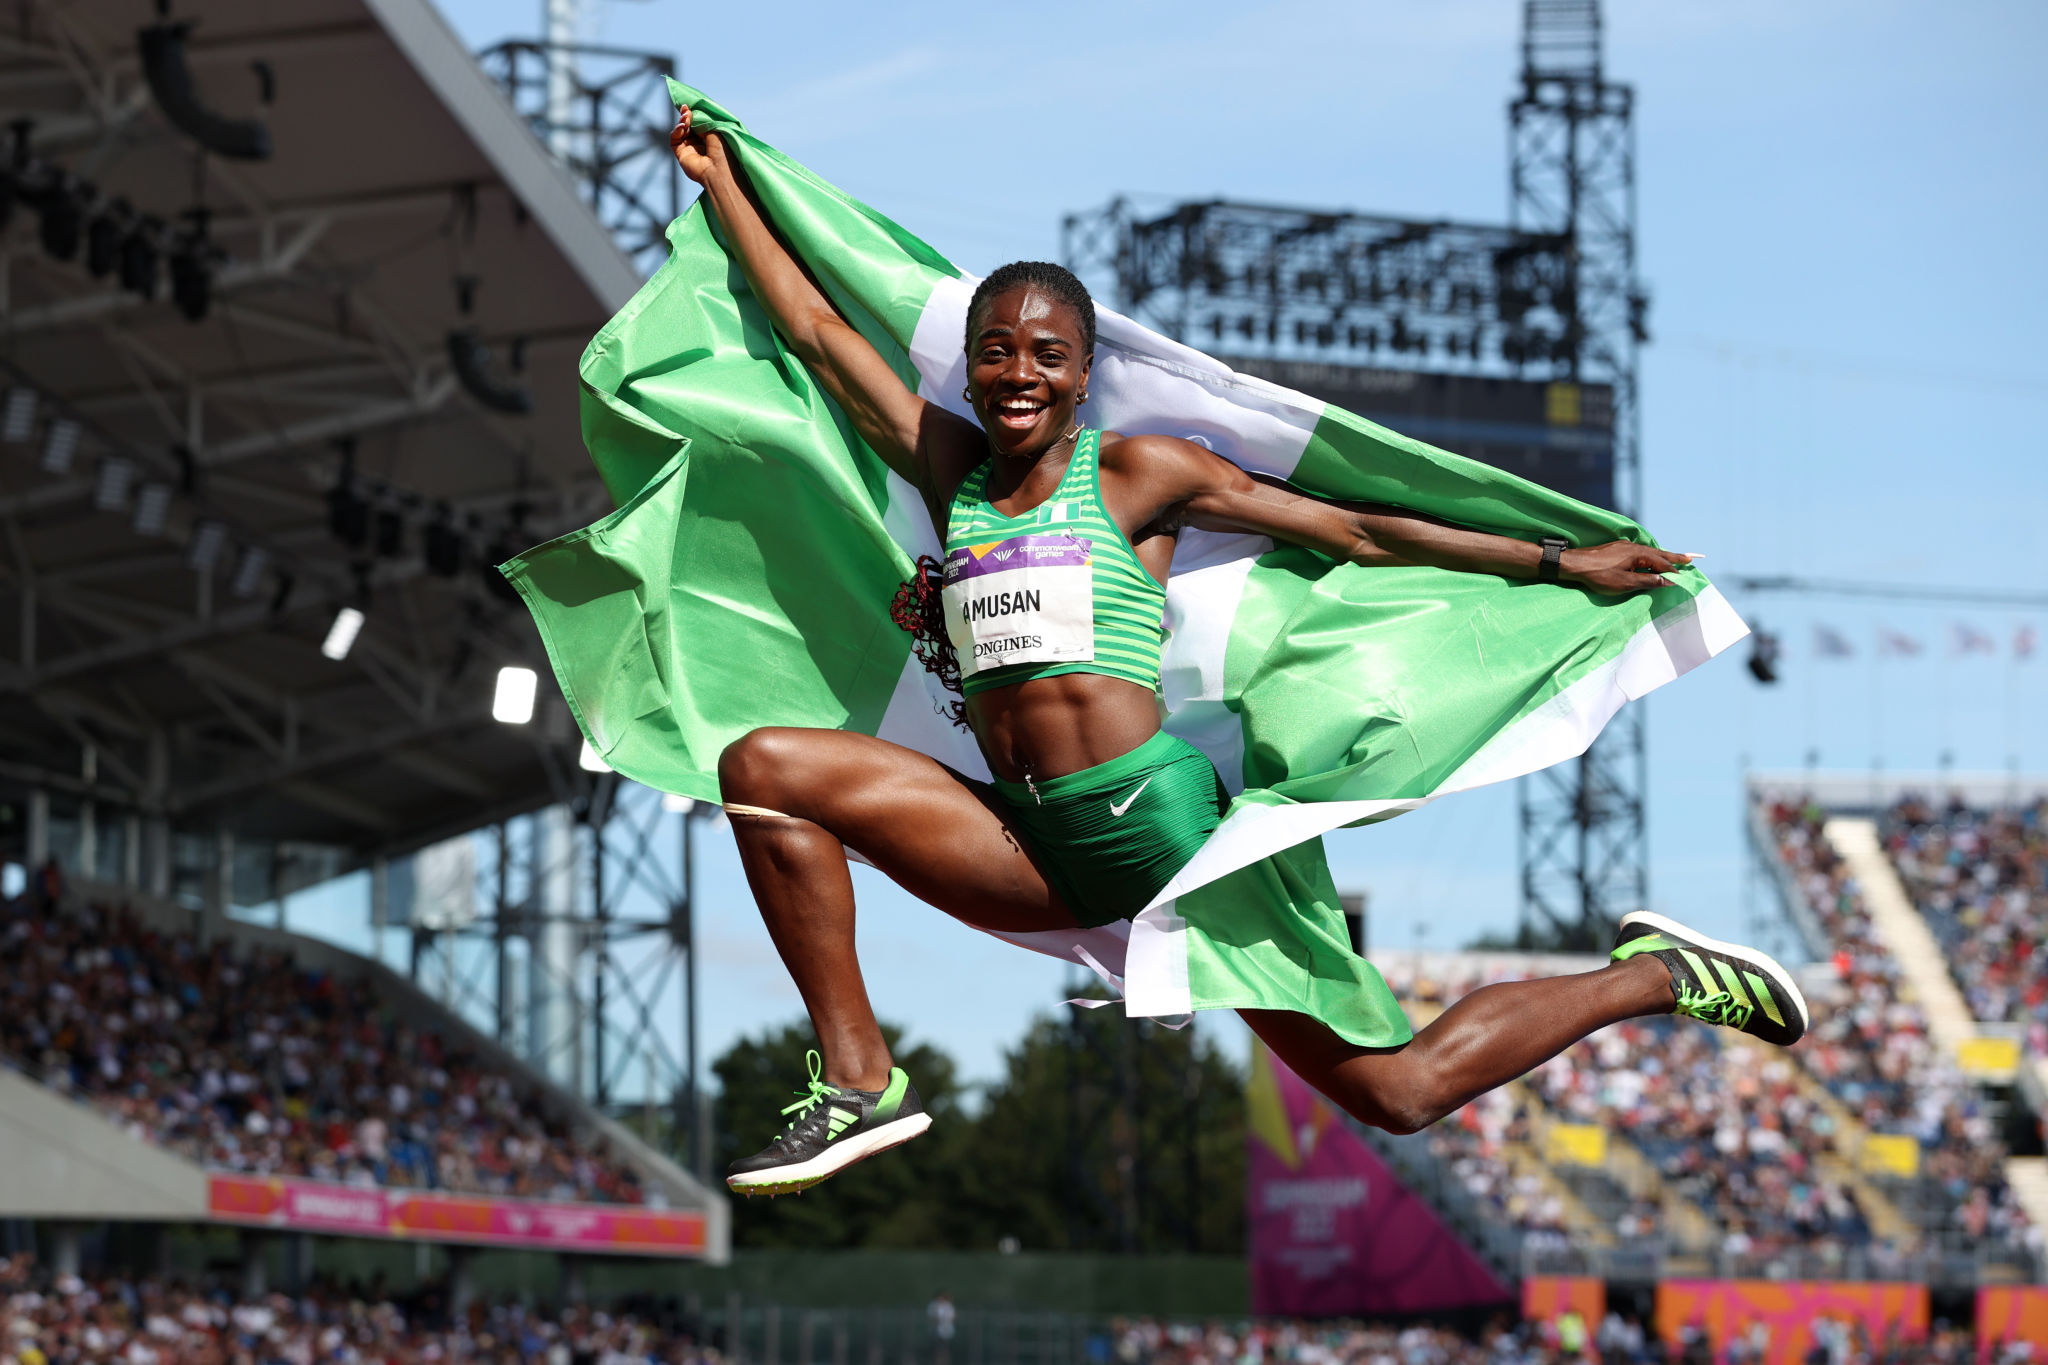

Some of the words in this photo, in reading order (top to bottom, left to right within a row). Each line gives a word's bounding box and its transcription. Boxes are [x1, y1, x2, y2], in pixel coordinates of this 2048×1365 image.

[1035, 551, 1065, 559] games
[963, 589, 1040, 624] AMUSAN
[973, 635, 1042, 659] ONGINES
